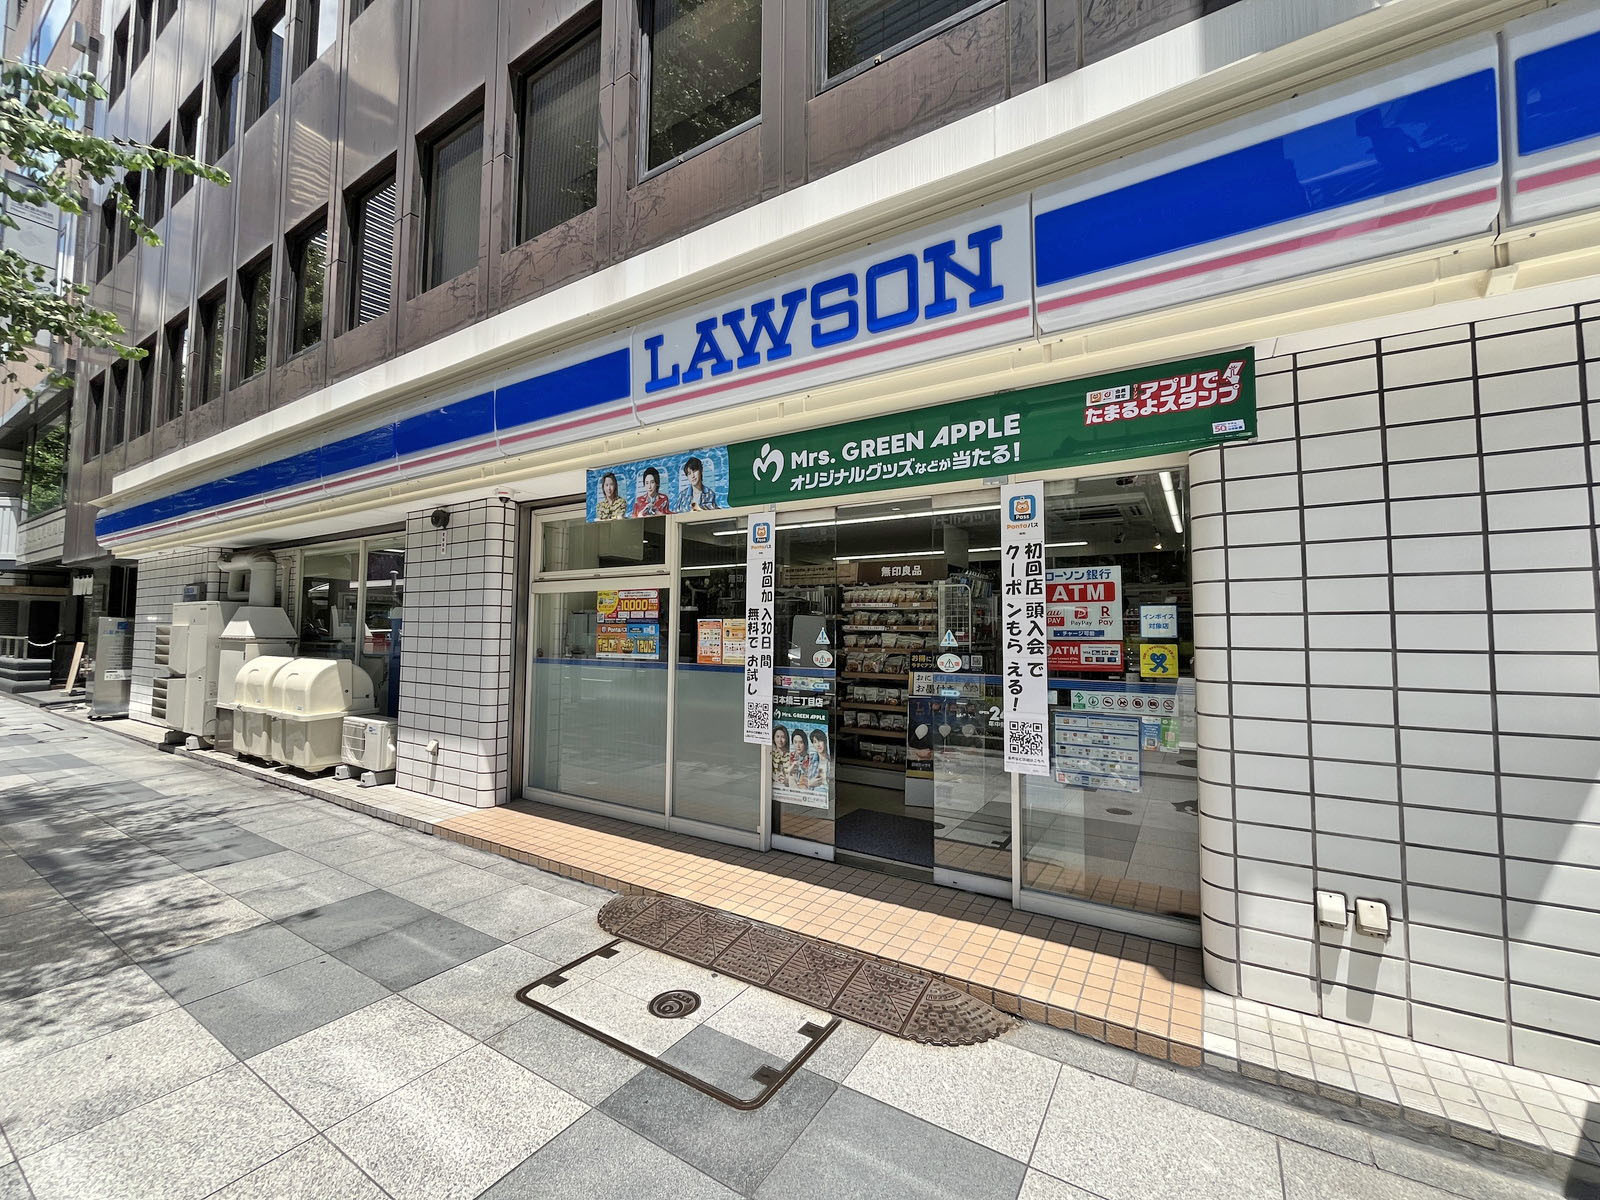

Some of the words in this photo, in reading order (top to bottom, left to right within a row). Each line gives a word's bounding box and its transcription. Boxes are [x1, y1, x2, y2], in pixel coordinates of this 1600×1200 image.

[644, 224, 1004, 394] LAWSON
[1085, 384, 1240, 424] たまるよスタンプ
[1140, 370, 1219, 400] アプリで
[790, 449, 836, 470] Mrs.
[841, 430, 924, 461] GREEN
[930, 413, 1021, 448] APPLE
[881, 564, 922, 577] 無印良品
[1046, 569, 1111, 581] ローソン銀行
[1024, 542, 1044, 678] 初回店頭入会で
[1052, 584, 1104, 602] ATM
[760, 560, 773, 669] 初回加入30日間
[746, 607, 760, 696] 無料でお試し
[1053, 646, 1079, 655] ATM
